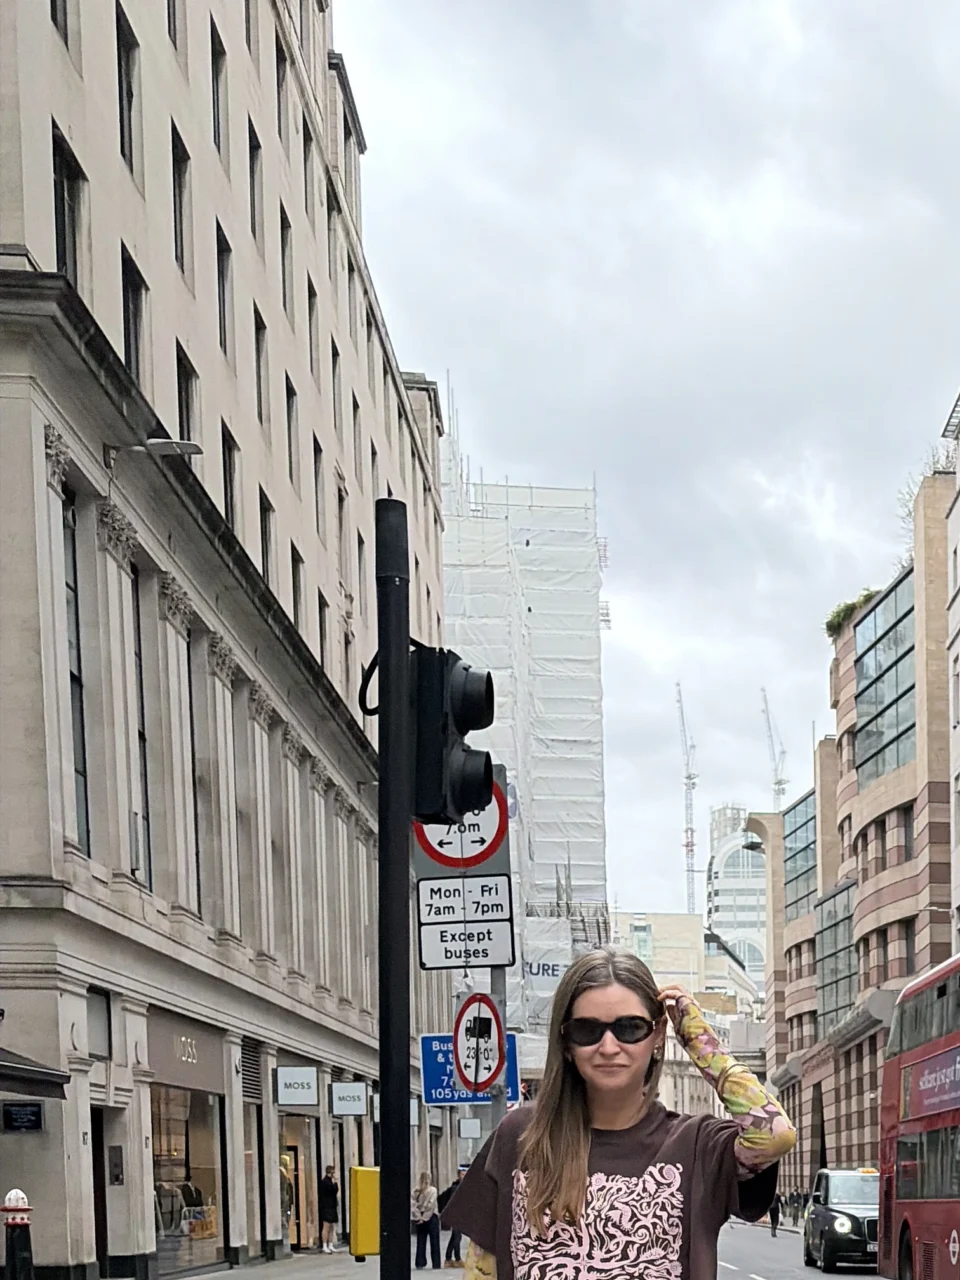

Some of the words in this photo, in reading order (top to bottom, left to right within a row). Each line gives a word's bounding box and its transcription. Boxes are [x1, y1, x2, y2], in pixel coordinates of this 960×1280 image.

[430, 887, 461, 900] Mon
[480, 883, 499, 897] Fri
[425, 903, 455, 916] 7am
[472, 901, 504, 916] 7pm
[440, 928, 493, 944] Except
[444, 946, 489, 959] buses
[525, 962, 560, 977] URE
[283, 1082, 311, 1090] MOSS
[431, 1088, 452, 1099] 105
